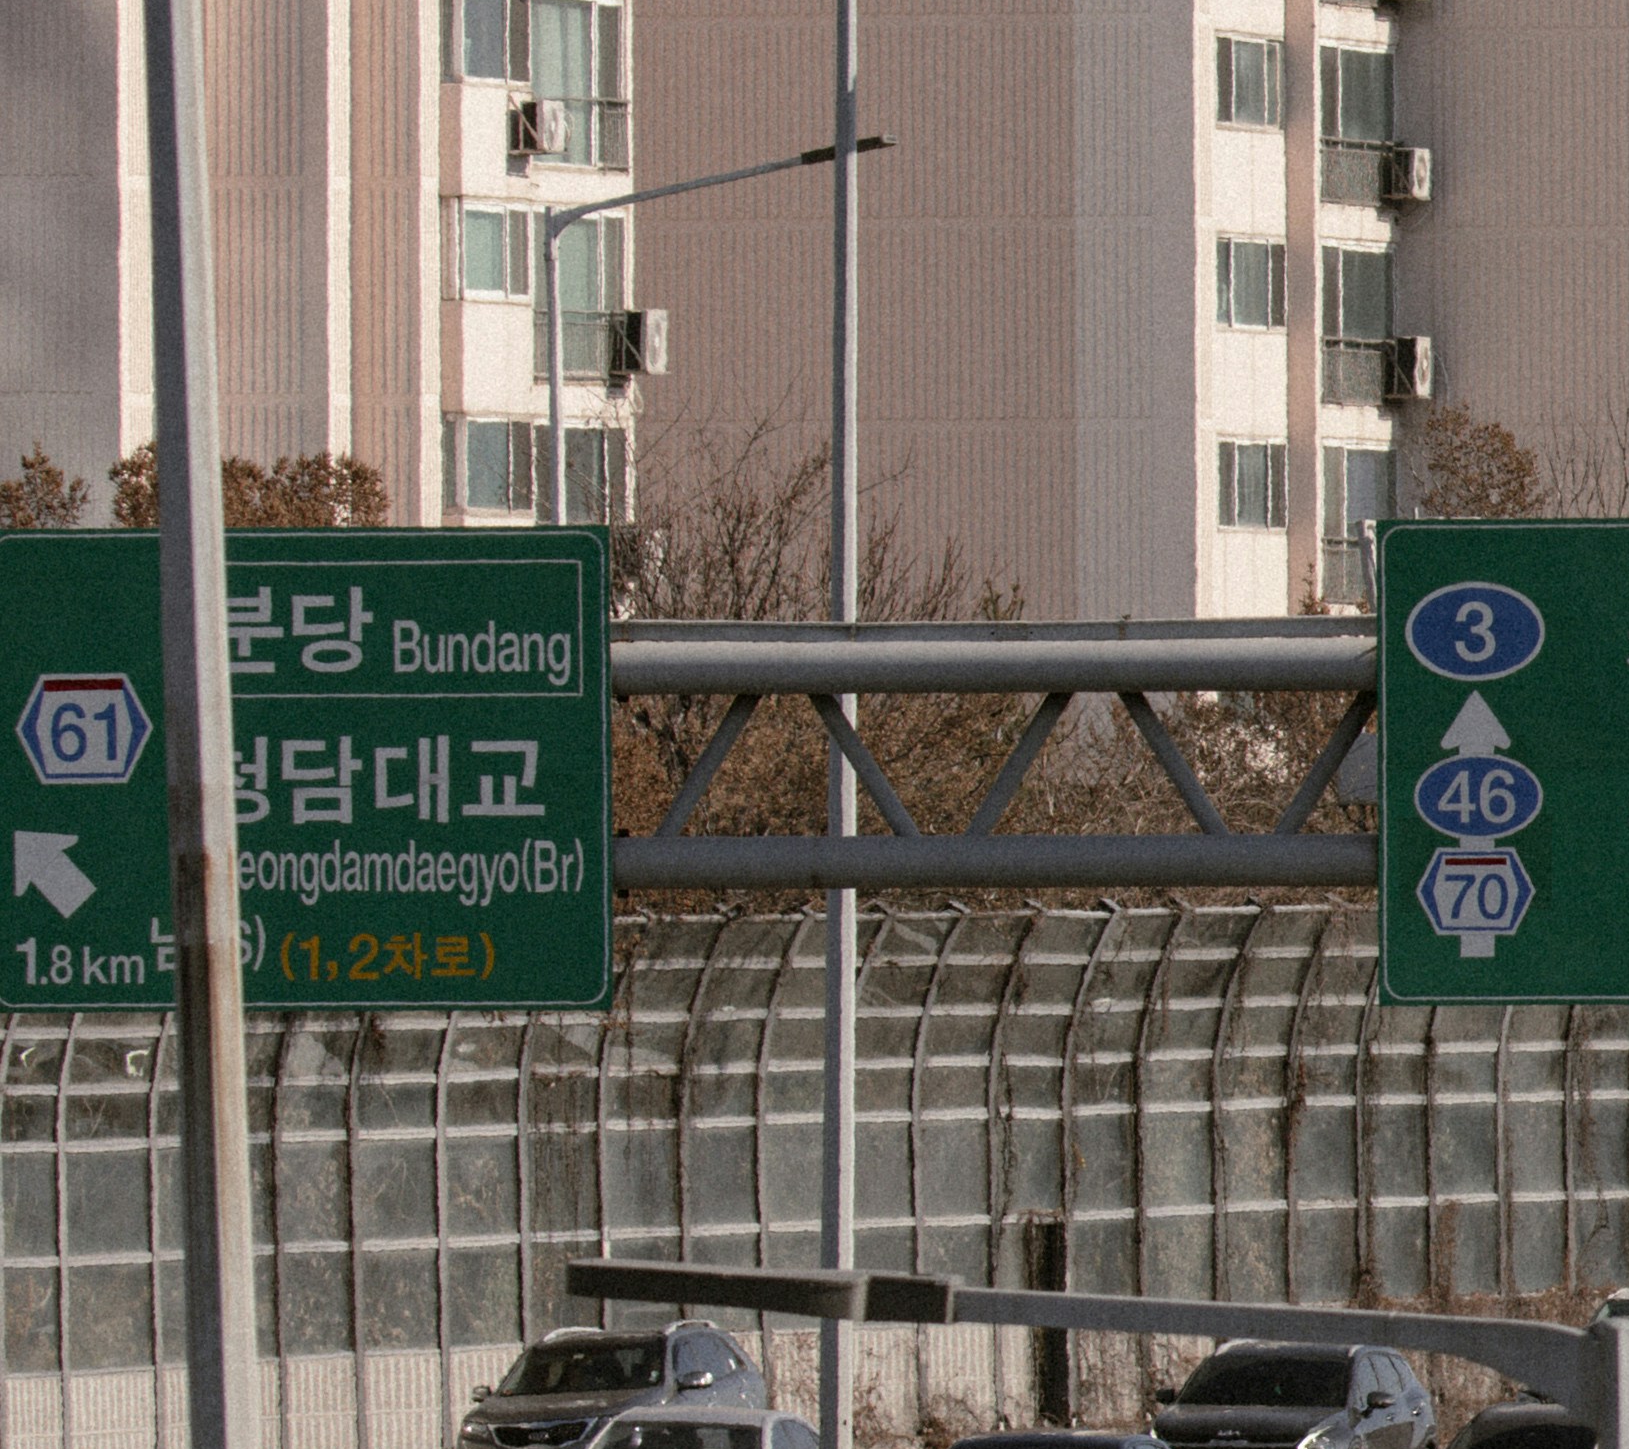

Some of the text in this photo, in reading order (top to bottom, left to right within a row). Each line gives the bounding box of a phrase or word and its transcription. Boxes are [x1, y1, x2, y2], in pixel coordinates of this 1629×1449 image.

[394, 618, 572, 686] Bundang
[1453, 600, 1497, 663] 3
[50, 702, 120, 763] 61
[1437, 771, 1517, 825] 46
[238, 837, 585, 905] eongdamdaegyo(Br)
[1445, 873, 1507, 921] 70
